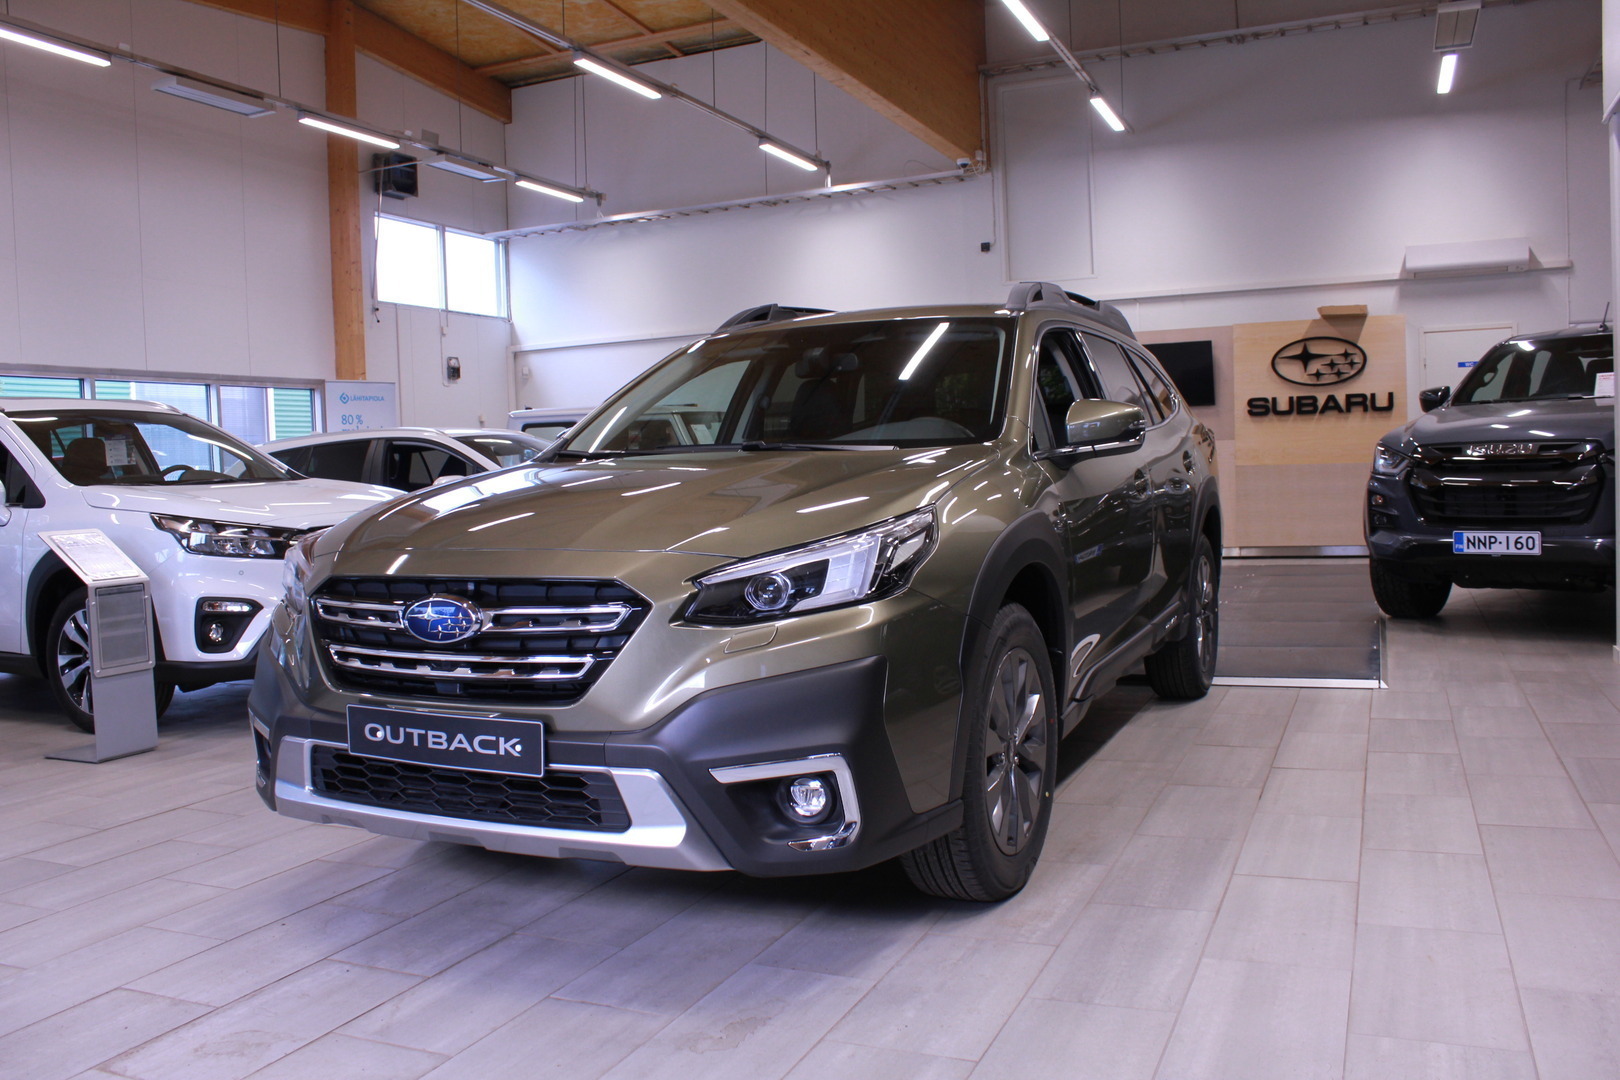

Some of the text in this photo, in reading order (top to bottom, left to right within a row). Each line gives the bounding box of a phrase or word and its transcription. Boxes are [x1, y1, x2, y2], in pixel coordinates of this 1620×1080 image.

[1247, 392, 1394, 416] SUBARU
[341, 414, 363, 425] 80 %
[1466, 443, 1533, 456] ISUZU
[1466, 535, 1535, 551] NNP-160
[364, 723, 522, 757] OUTBACK
